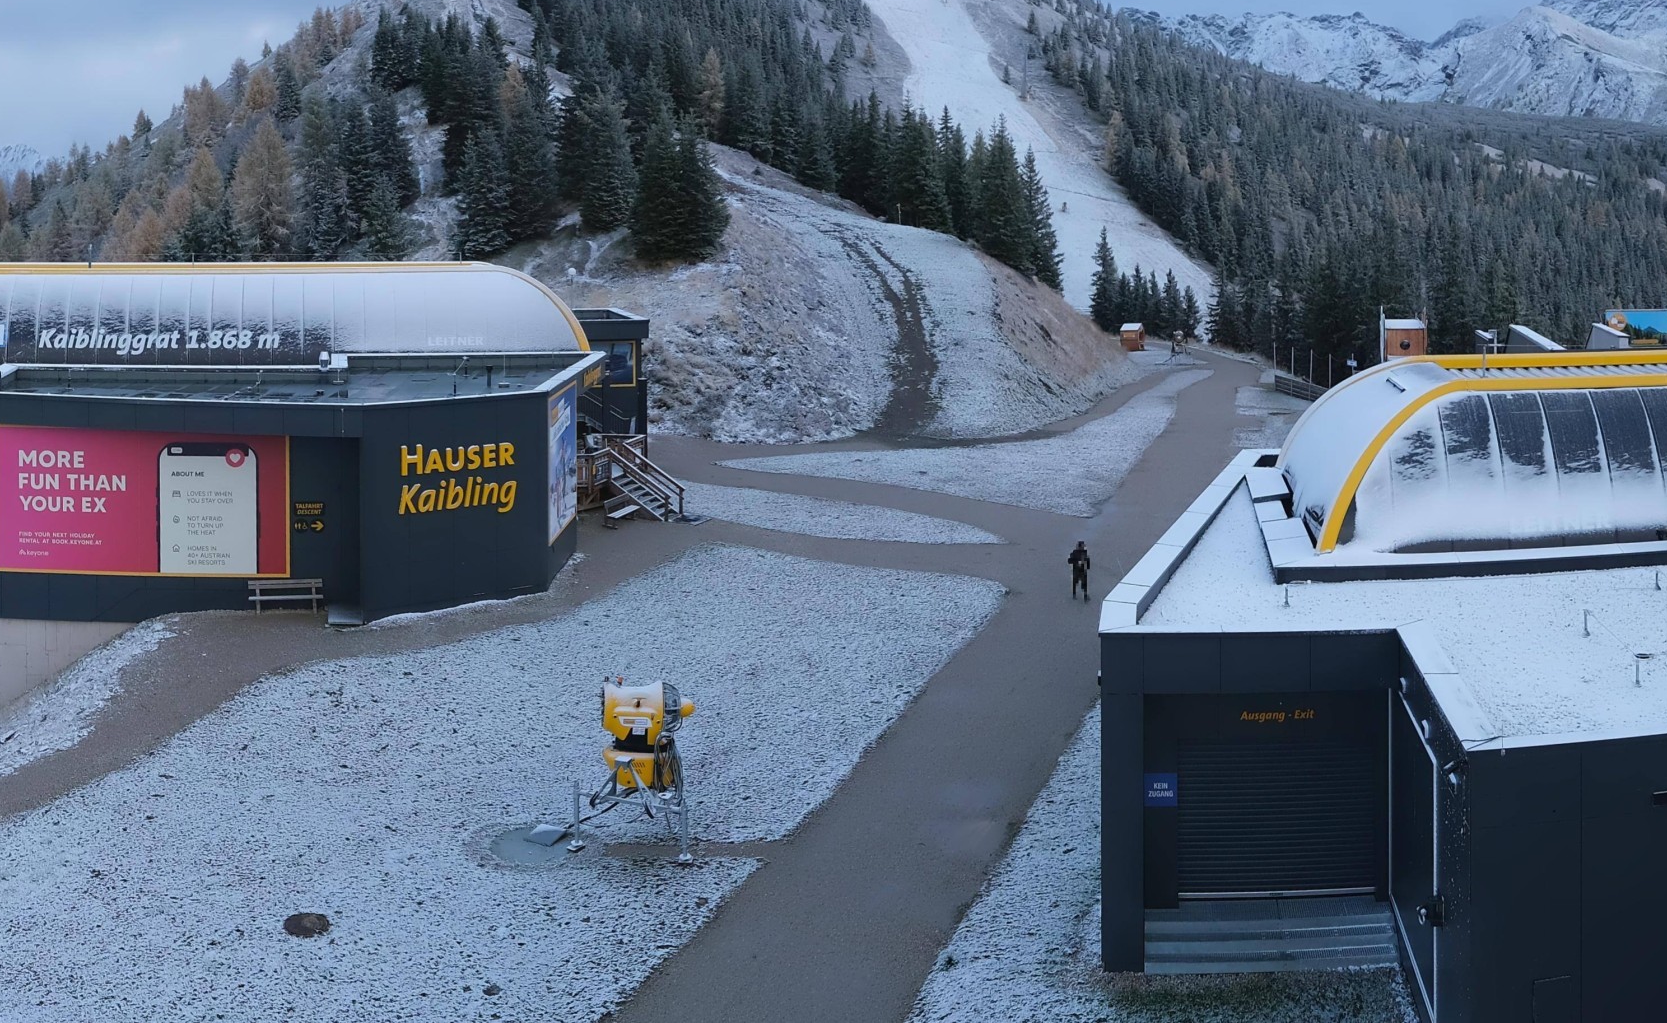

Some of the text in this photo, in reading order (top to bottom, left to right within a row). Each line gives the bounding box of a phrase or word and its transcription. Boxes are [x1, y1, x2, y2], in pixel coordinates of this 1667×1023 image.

[39, 328, 280, 355] Kaiblinggrat 1.868 m
[428, 336, 484, 346] LEITNER
[18, 449, 85, 468] MORE
[400, 442, 515, 476] HAUSER
[18, 473, 127, 491] FUN THAN
[19, 495, 107, 513] YOUR EX
[398, 476, 517, 515] Kaibling
[26, 549, 49, 557] keyone
[1239, 710, 1286, 723] Ausgang
[1294, 709, 1315, 719] Exit
[1148, 790, 1174, 798] ZUGANG
